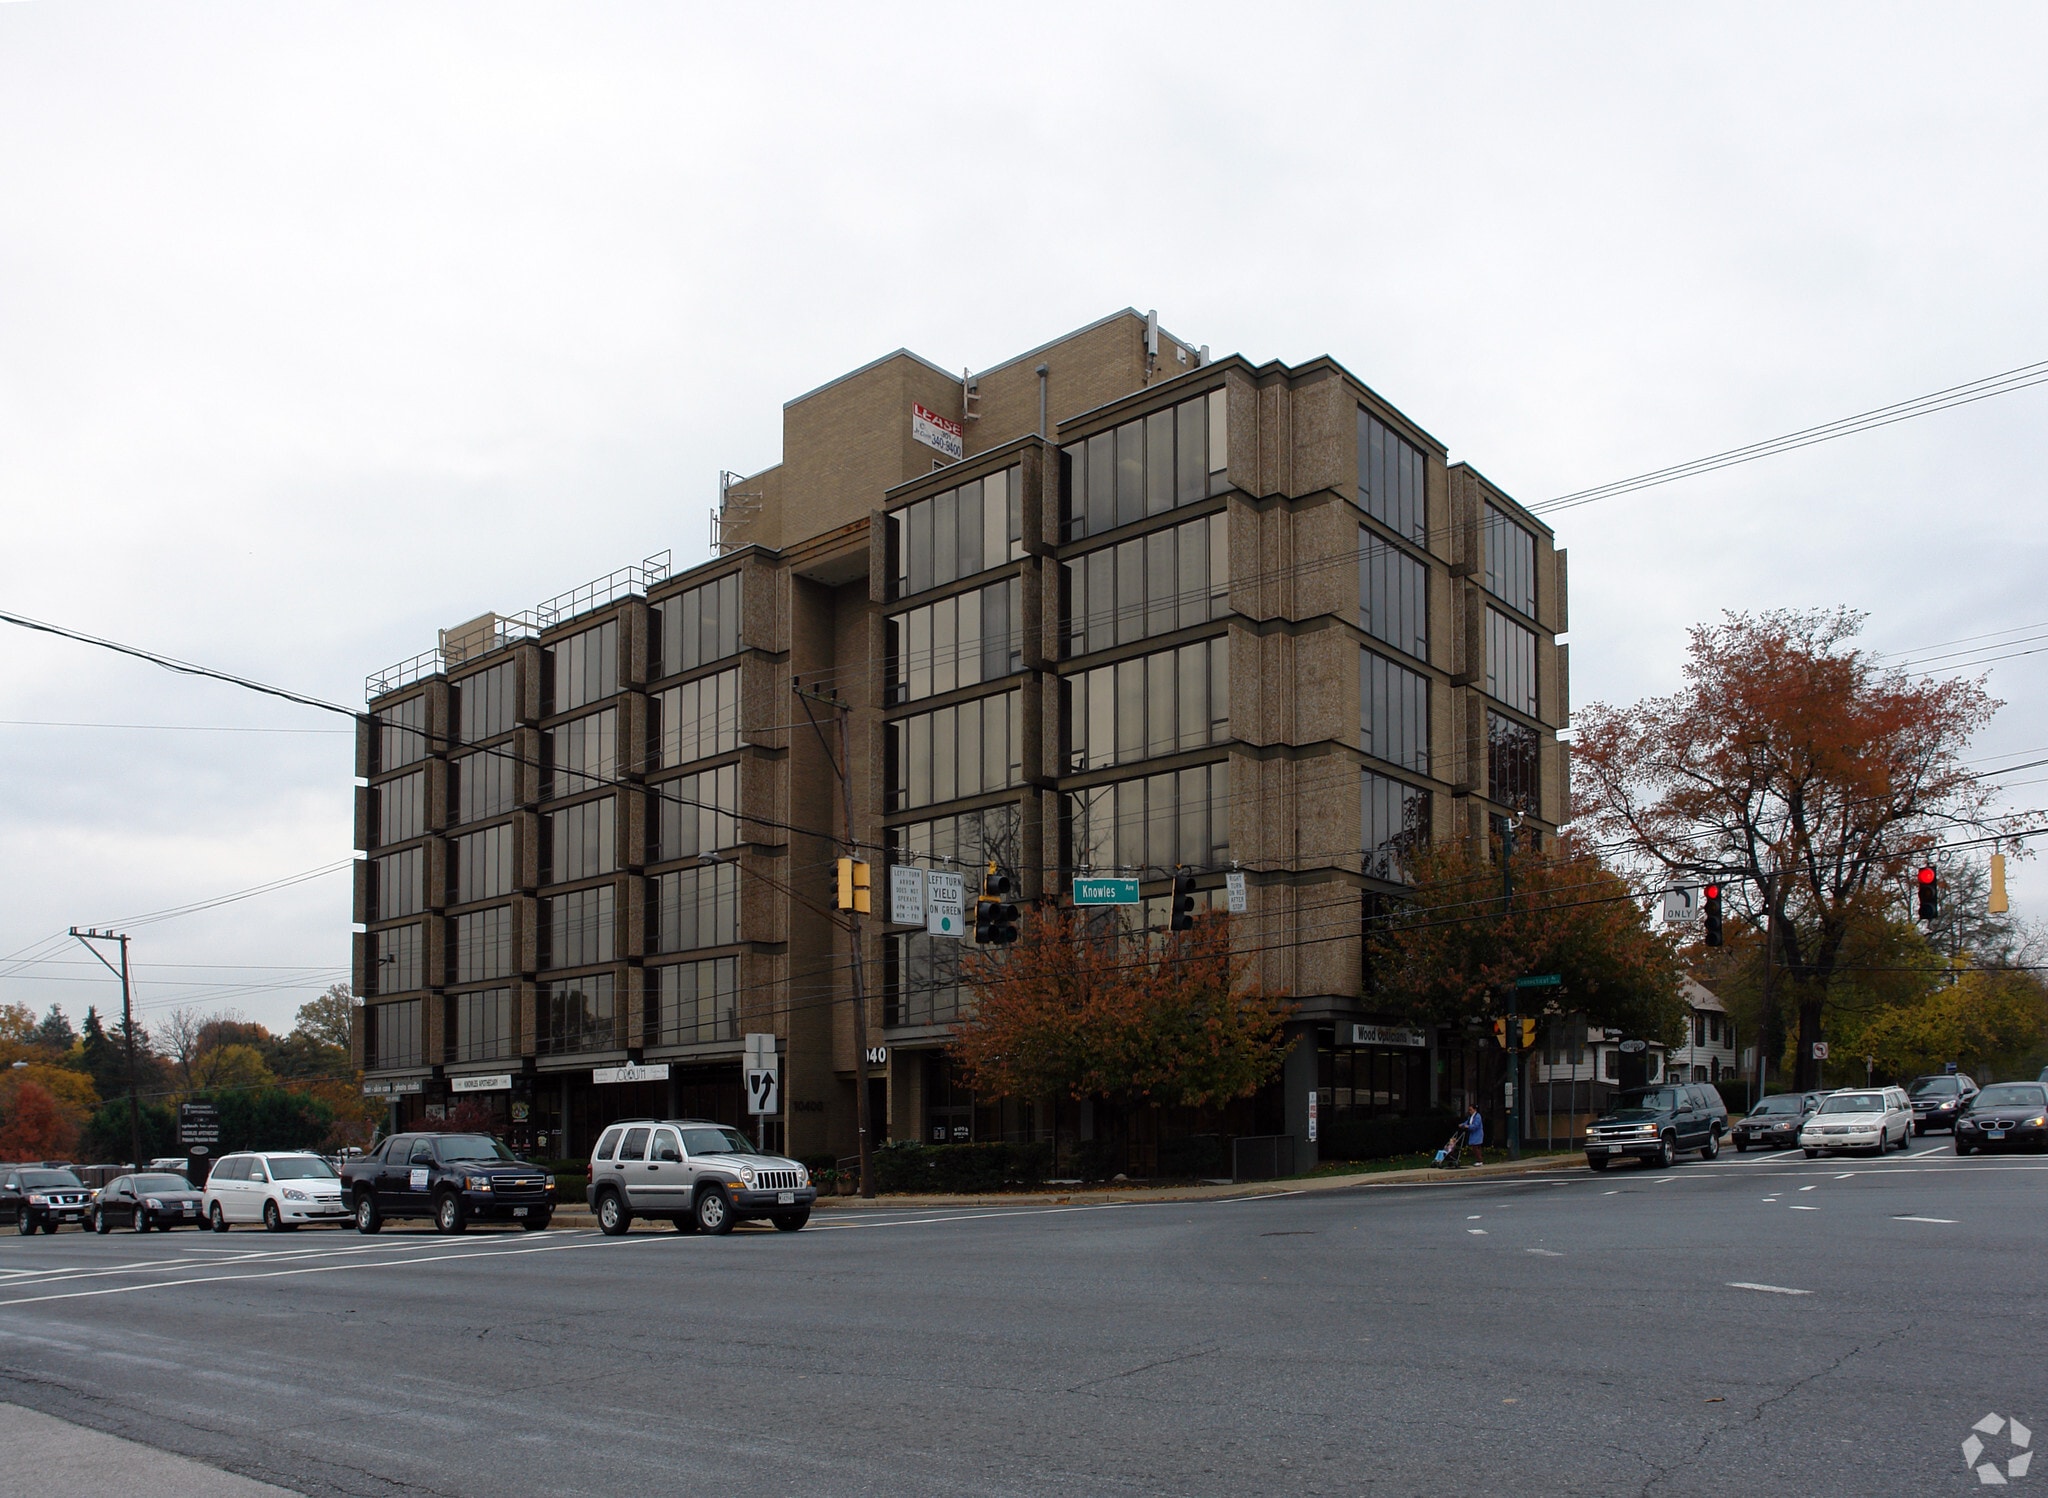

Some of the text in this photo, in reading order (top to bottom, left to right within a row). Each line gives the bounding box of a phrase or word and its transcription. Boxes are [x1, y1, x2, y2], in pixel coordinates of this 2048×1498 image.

[914, 403, 961, 436] LEASE
[894, 869, 920, 878] LEFT TURN
[928, 875, 961, 886] LEFT TURN
[933, 887, 957, 900] YIELD
[1082, 884, 1116, 898] Knowles
[897, 895, 918, 903] OPERATE
[929, 904, 961, 916] ON GREEN
[1668, 910, 1692, 918] ONLY
[1357, 1025, 1376, 1041] Wood
